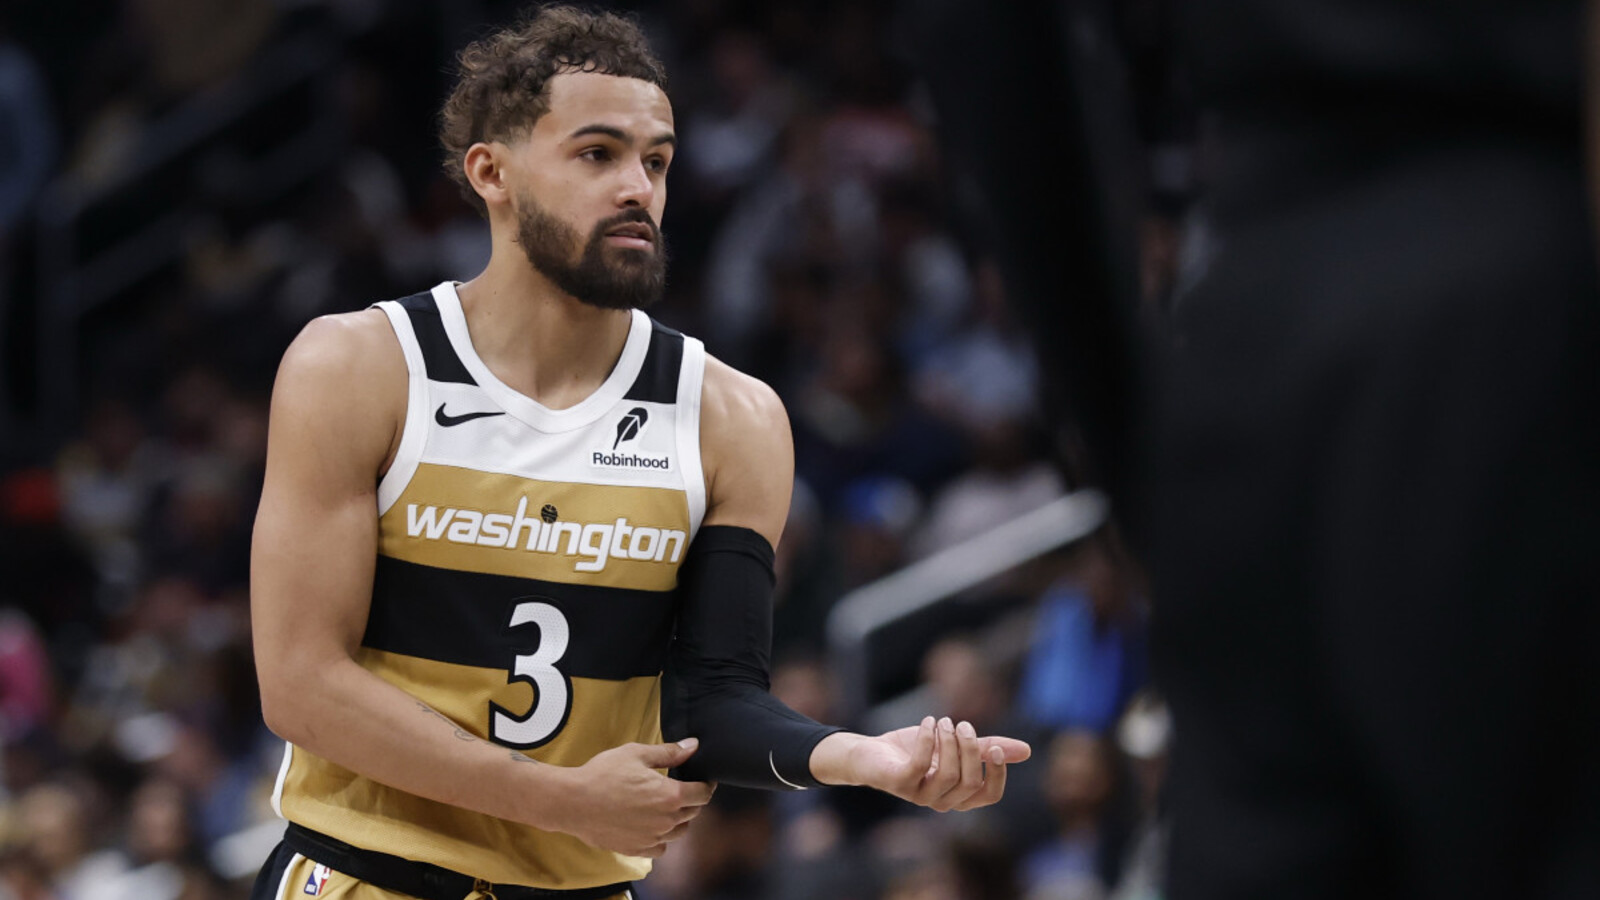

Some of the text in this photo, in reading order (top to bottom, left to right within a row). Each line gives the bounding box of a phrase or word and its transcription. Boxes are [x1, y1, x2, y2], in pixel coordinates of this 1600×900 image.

[592, 452, 669, 470] Robinhood
[407, 495, 686, 572] washington
[490, 598, 572, 748] 3
